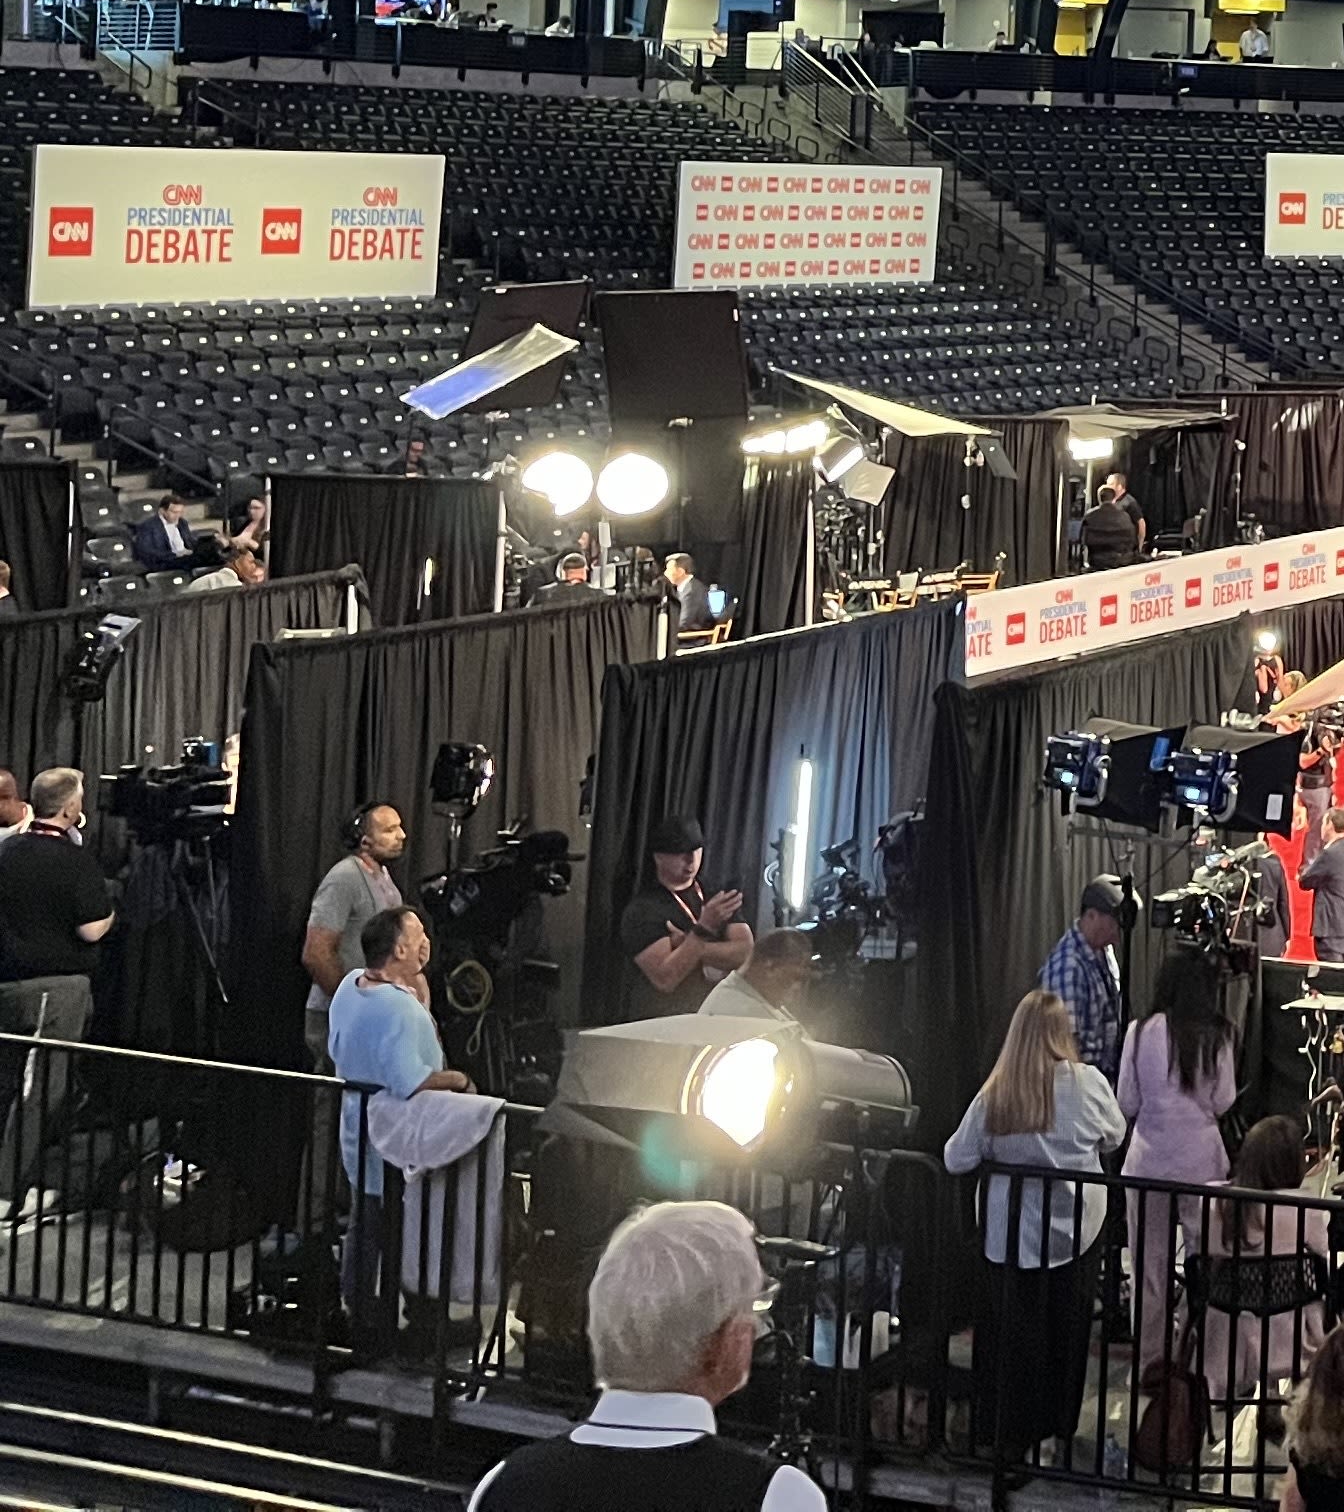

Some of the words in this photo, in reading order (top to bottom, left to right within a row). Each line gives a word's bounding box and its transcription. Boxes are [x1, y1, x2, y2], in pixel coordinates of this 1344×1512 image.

[162, 184, 203, 206] CNN
[362, 186, 398, 207] CNN
[127, 207, 234, 227] PRESIDENTIAL
[331, 208, 425, 227] PRESIDENTIAL
[52, 221, 89, 242] CNN
[264, 221, 298, 241] CNN
[125, 228, 234, 264] DEBATE
[329, 228, 423, 261] DEBATE
[1289, 564, 1327, 591] DEBATE
[1213, 579, 1254, 608] DEBATE
[1039, 601, 1087, 620] PRESIDENTIAL
[1130, 595, 1174, 625] DEBATE
[1039, 614, 1087, 644] DEBATE
